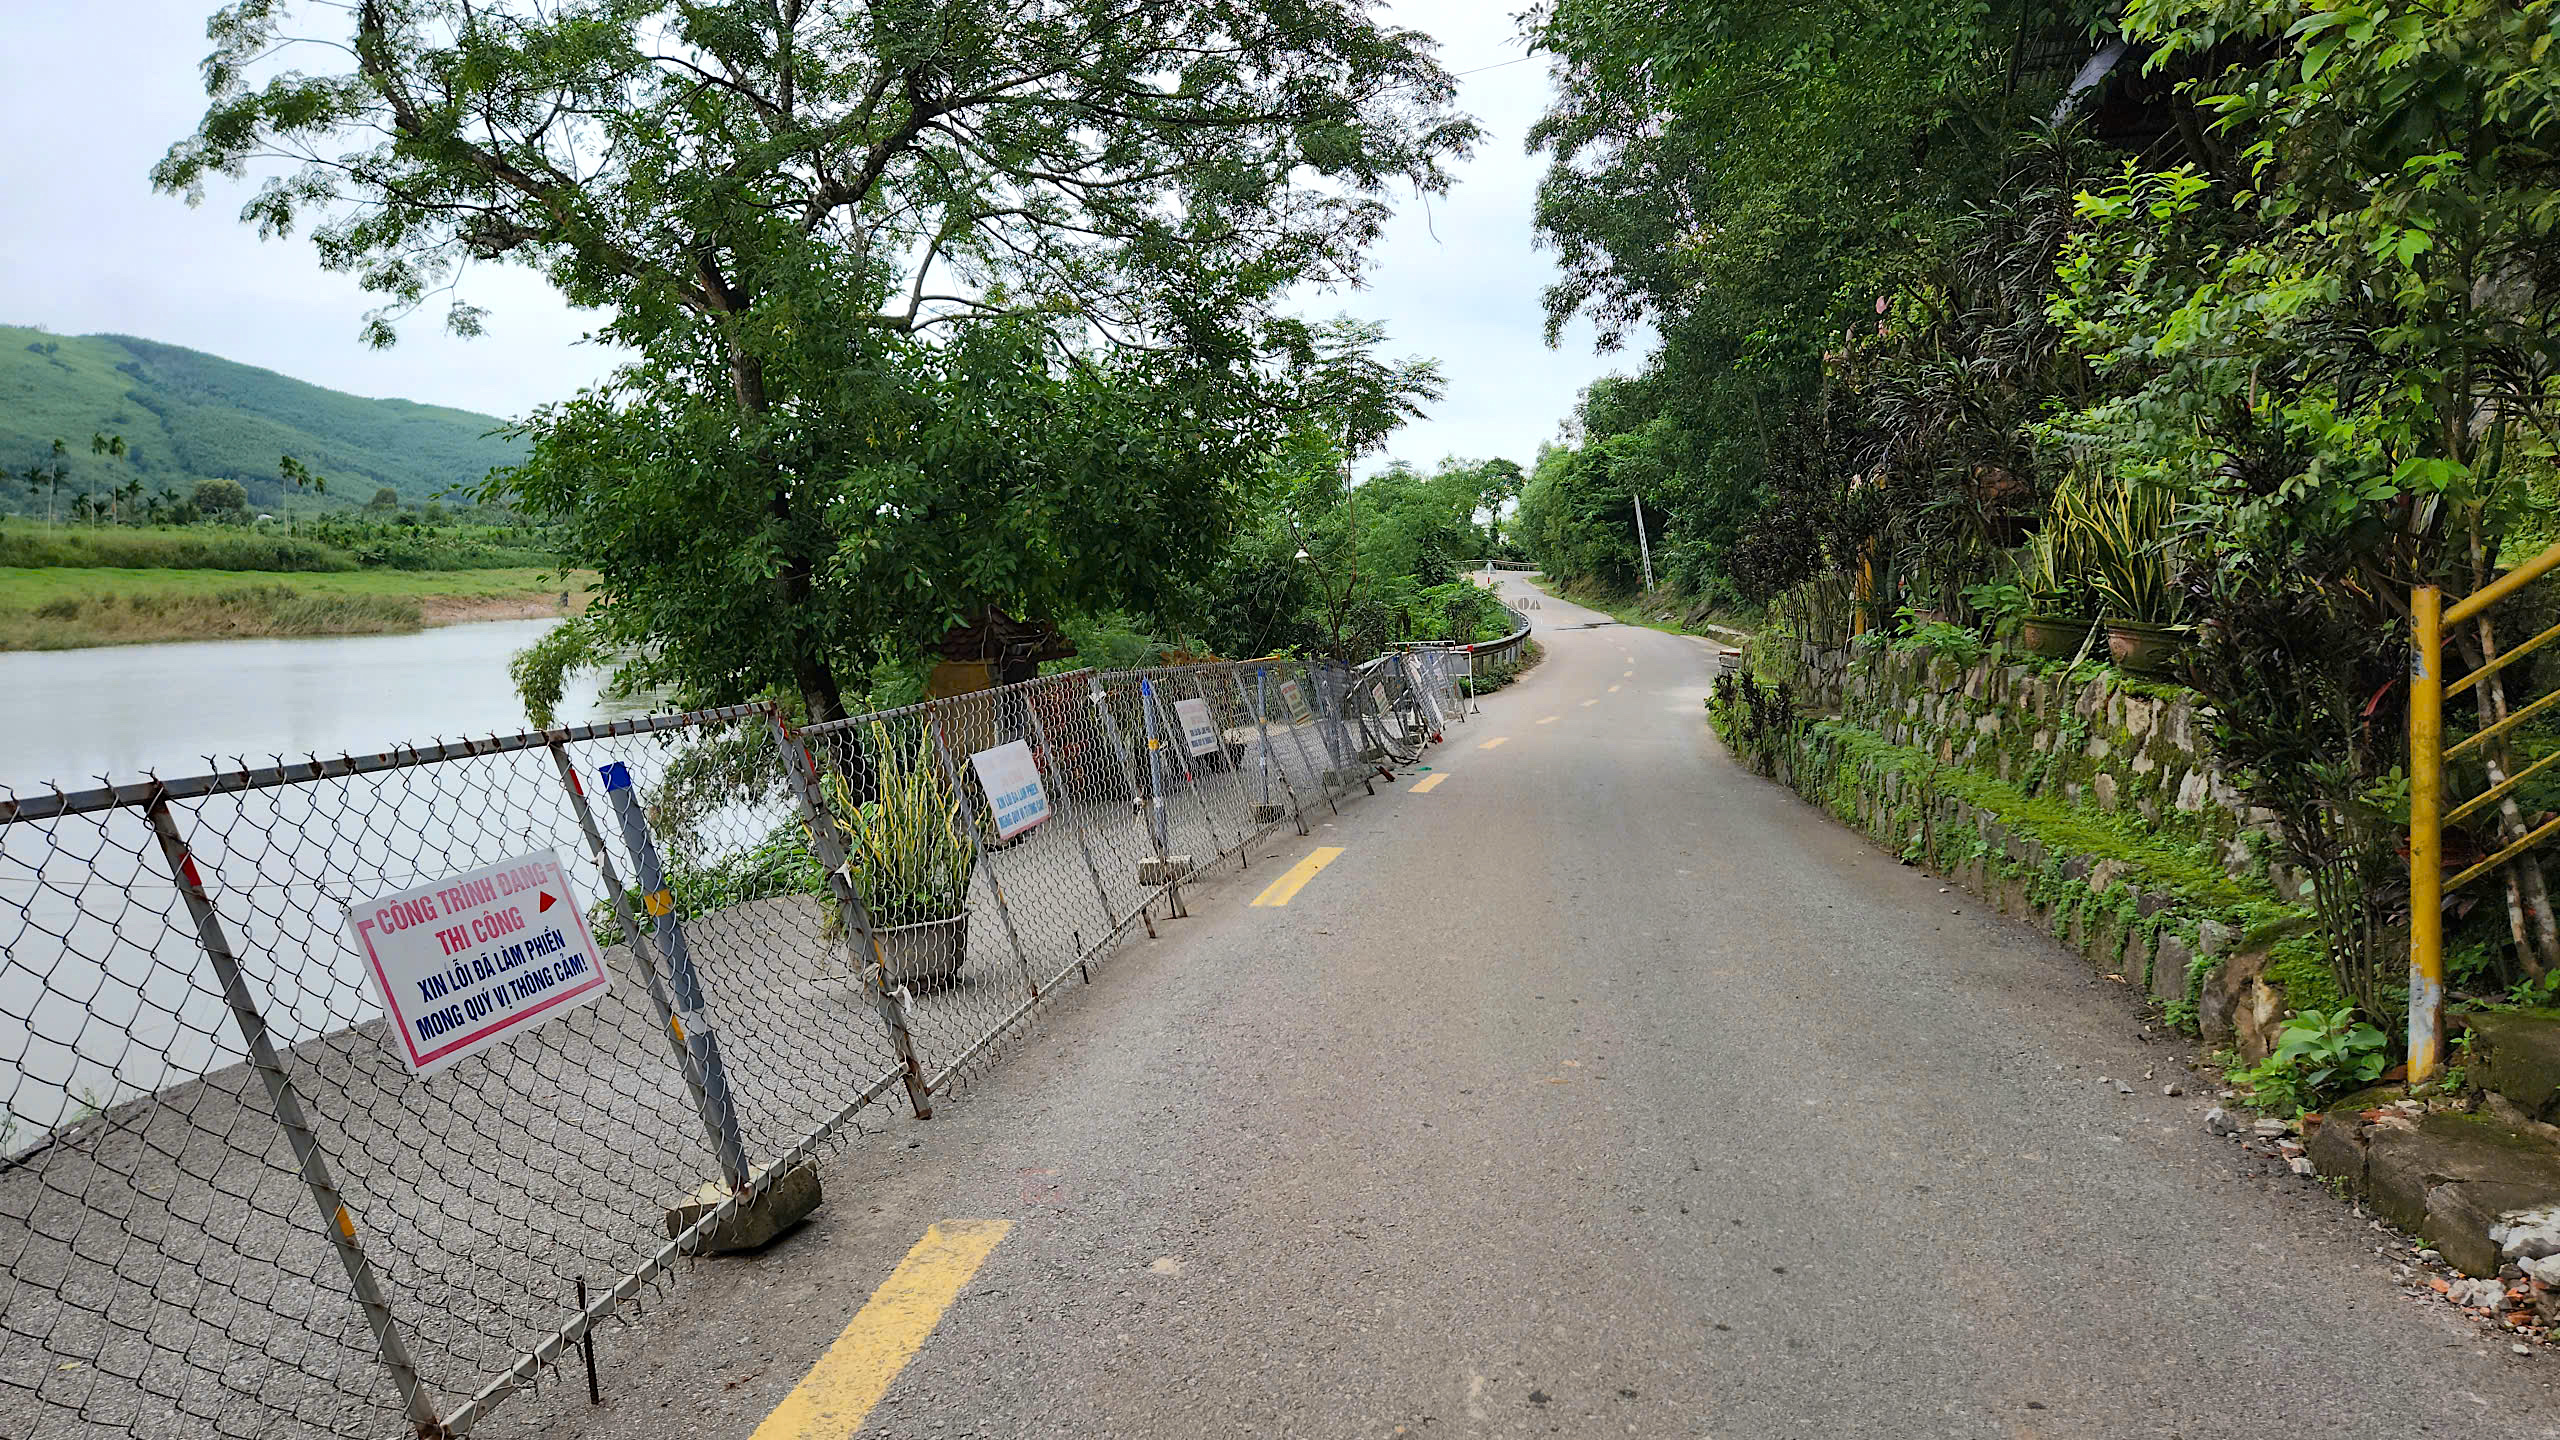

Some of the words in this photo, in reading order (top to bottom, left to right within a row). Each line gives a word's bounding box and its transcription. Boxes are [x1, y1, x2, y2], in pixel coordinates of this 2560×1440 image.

[375, 897, 437, 934] CÔNG
[436, 877, 497, 915] TRÌNH
[496, 862, 549, 897] ĐANG
[435, 923, 472, 956] THI
[472, 906, 526, 943] CÔNG
[416, 974, 448, 1003] XIN
[446, 959, 476, 991] LỖI
[474, 951, 497, 982] ĐÃ
[495, 940, 526, 973] LÀM
[525, 926, 566, 961] PHIỀN
[416, 1004, 466, 1042] MONG
[464, 987, 495, 1022] QUÝ
[493, 984, 513, 1010] VỊ
[508, 965, 555, 1001] THÔNG
[553, 951, 589, 982] CẢM!
